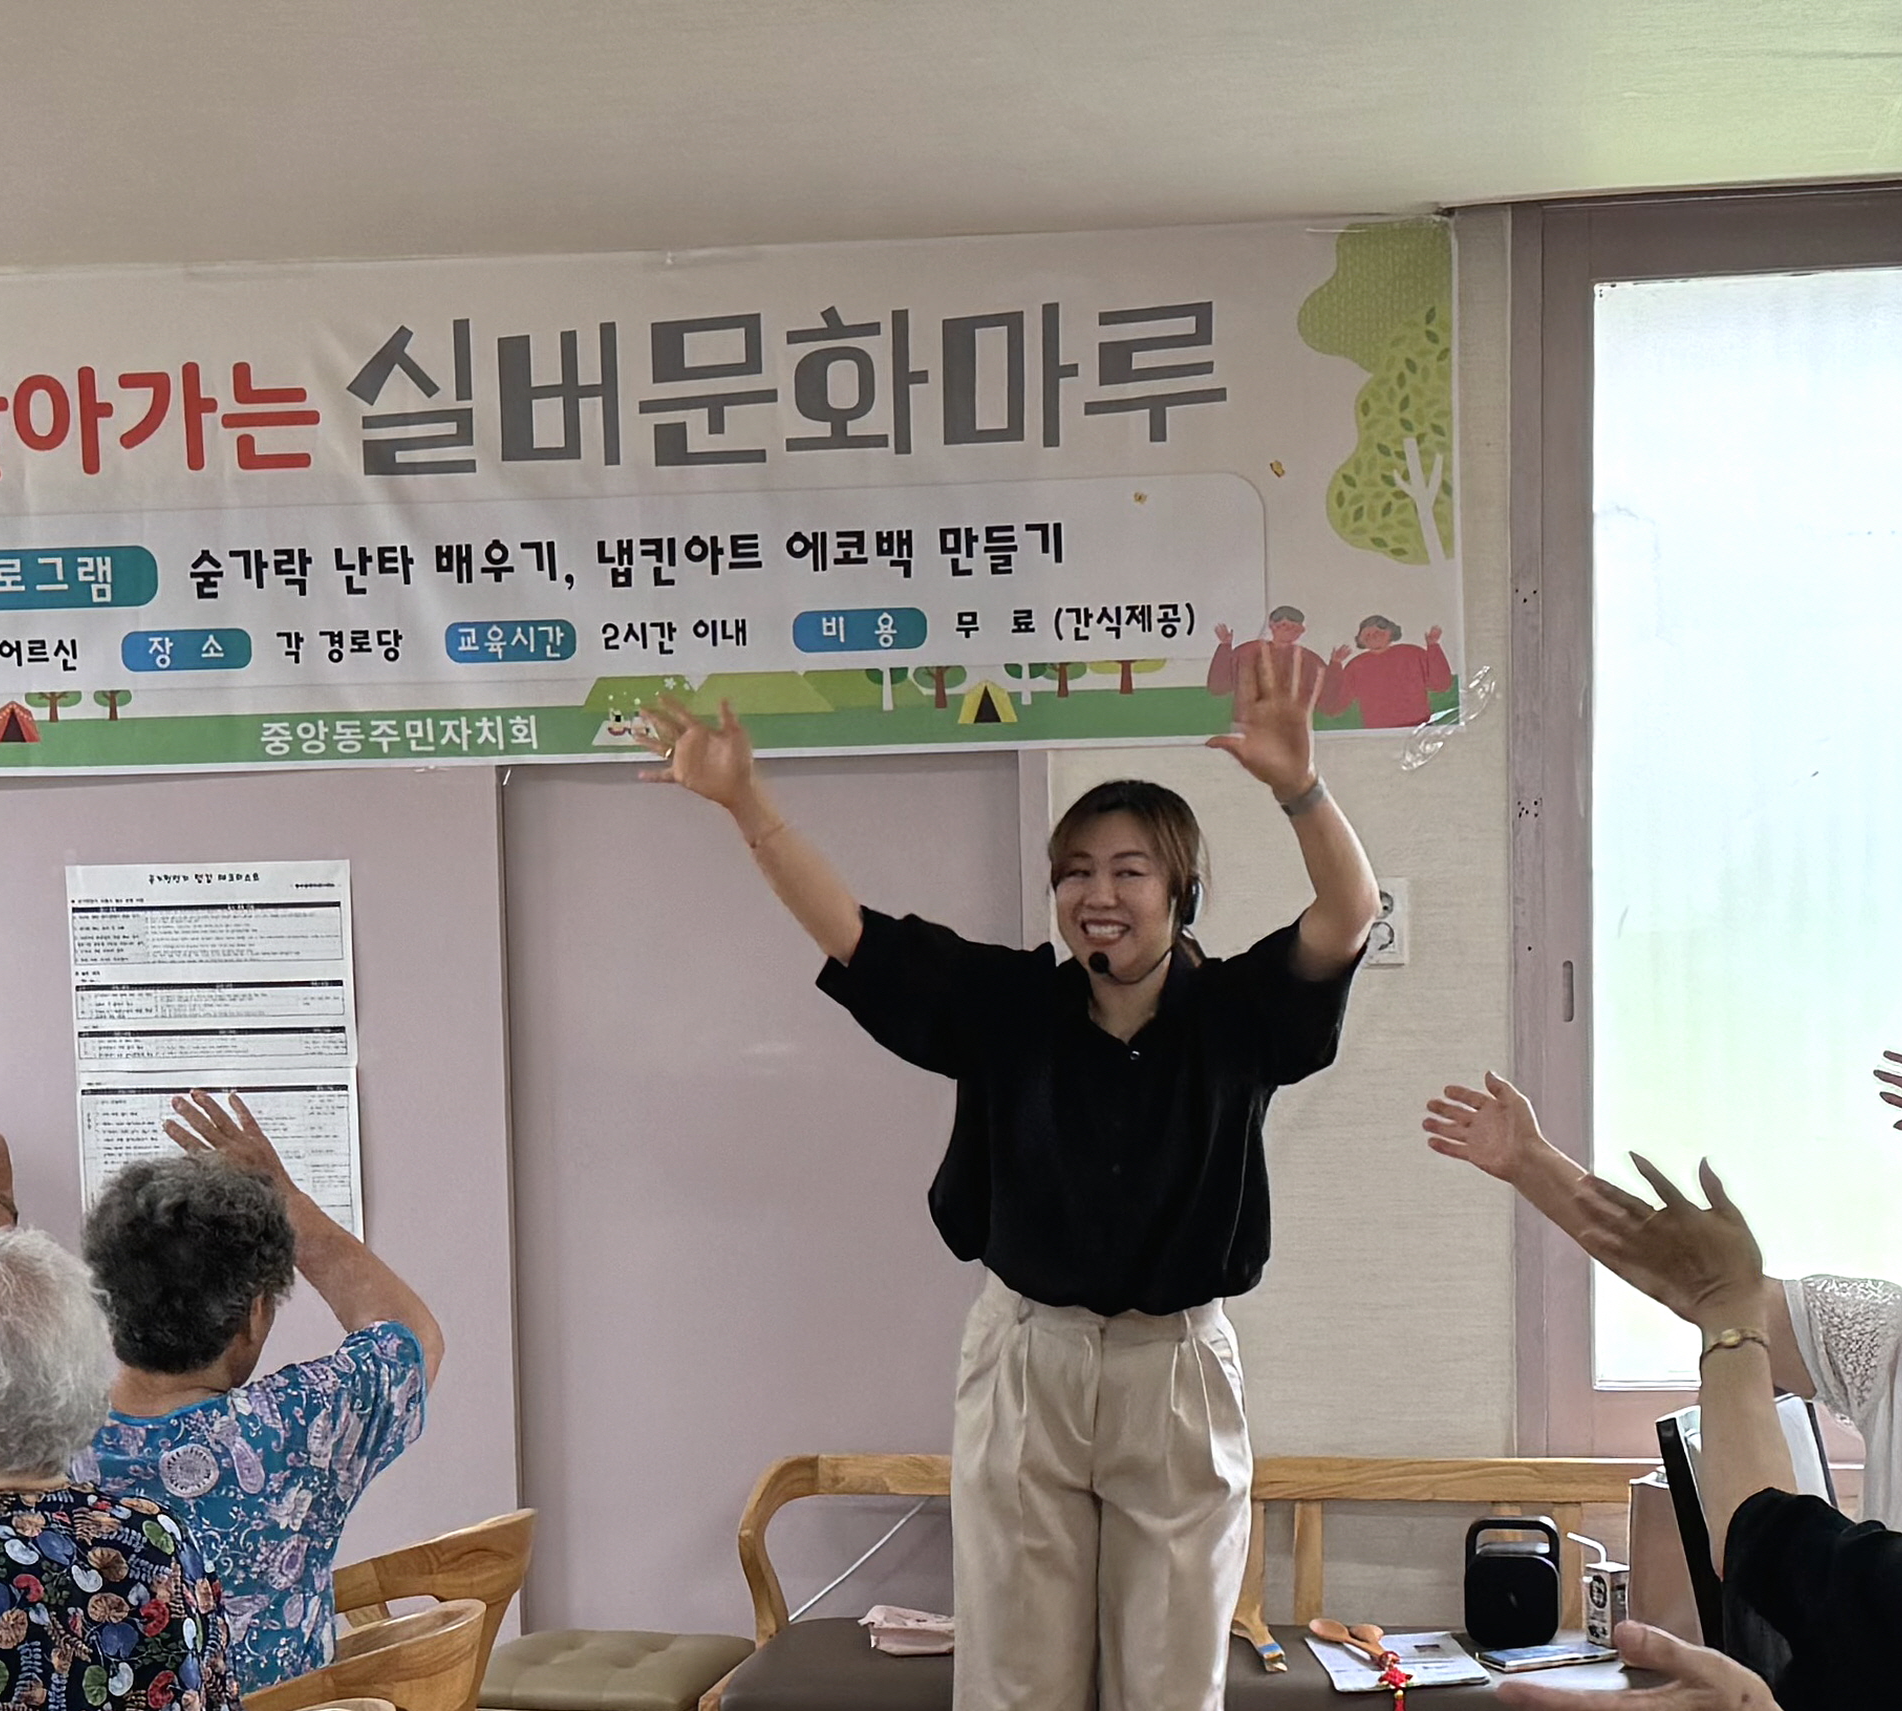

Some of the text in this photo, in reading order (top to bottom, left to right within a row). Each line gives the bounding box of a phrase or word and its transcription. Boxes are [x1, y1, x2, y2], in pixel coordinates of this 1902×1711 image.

[346, 301, 1227, 475] 실버문화마루
[190, 549, 312, 599] 숟가락
[335, 546, 414, 594] 난타
[435, 539, 573, 590] 배우기,
[597, 534, 762, 587] 냅킨아트
[786, 530, 912, 578] 에코백
[940, 523, 1062, 576] 만들기
[276, 632, 303, 664] 각
[319, 629, 402, 663] 경로당
[457, 625, 565, 660] 교육시간
[602, 622, 676, 654] 2시간
[693, 619, 746, 646] 이내
[1055, 603, 1194, 641] (간식제공)
[260, 716, 539, 756] 중앙동주민자치회
